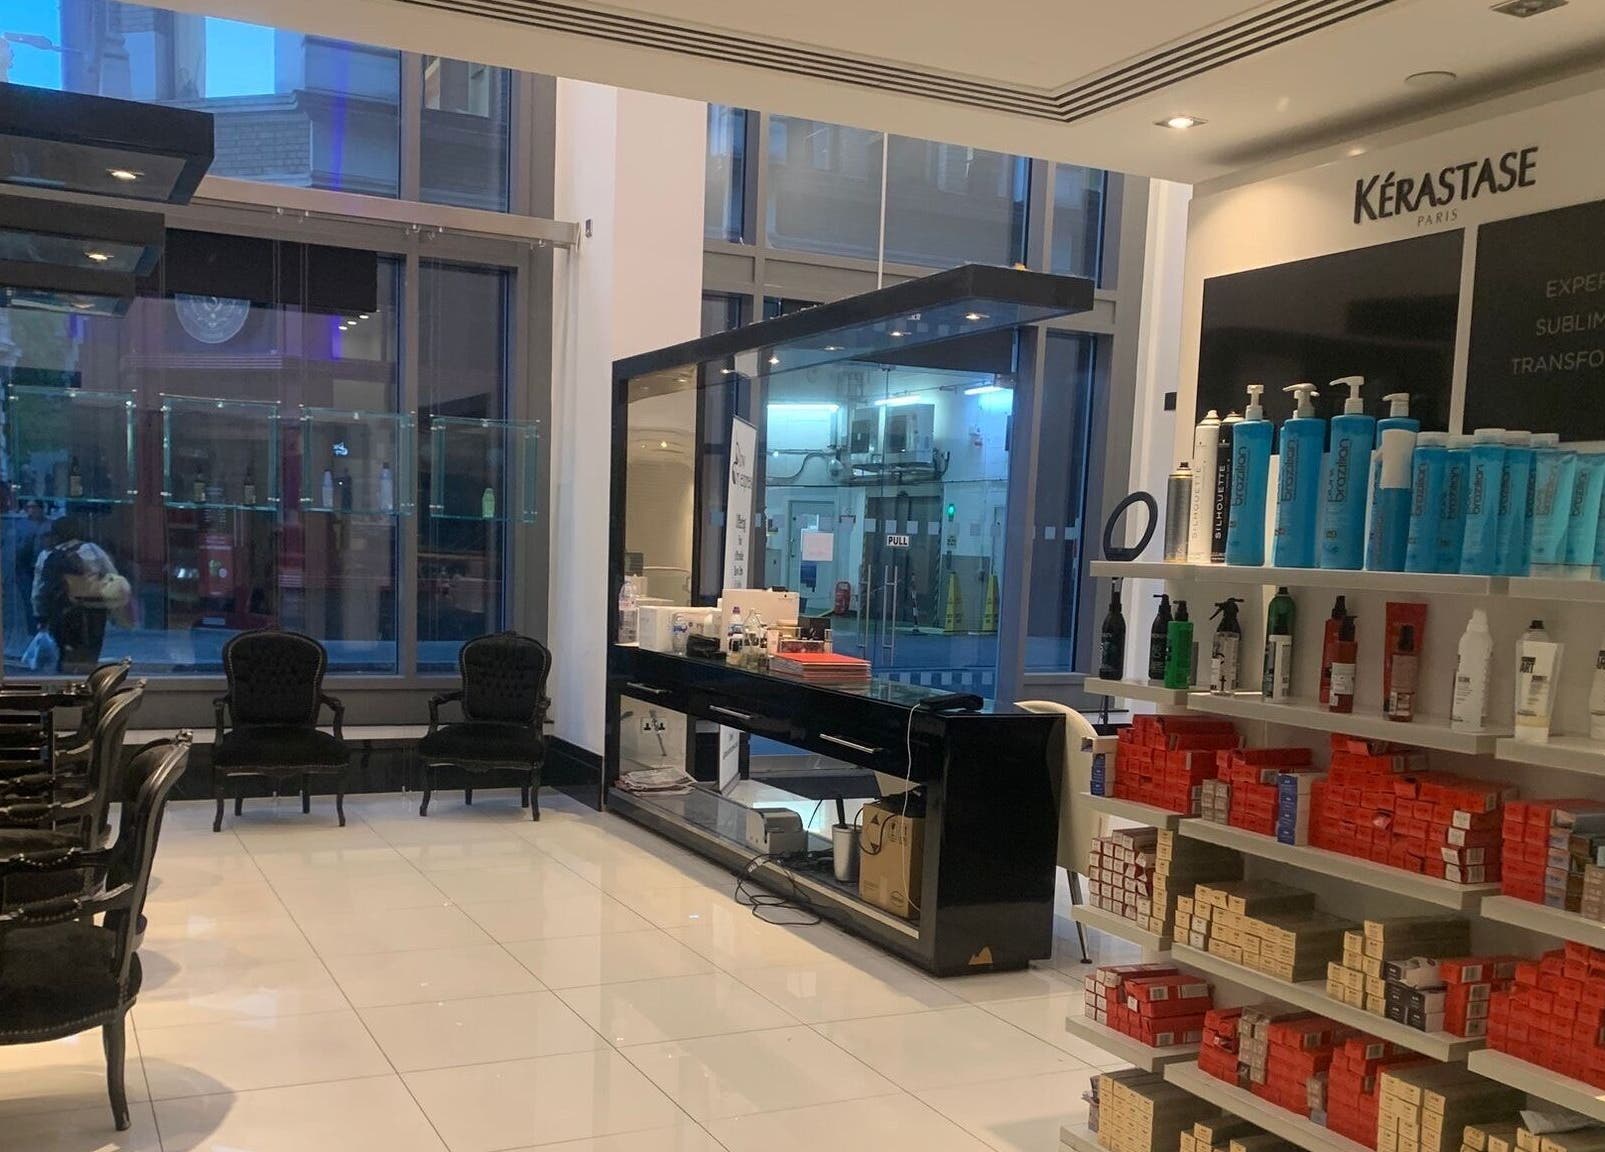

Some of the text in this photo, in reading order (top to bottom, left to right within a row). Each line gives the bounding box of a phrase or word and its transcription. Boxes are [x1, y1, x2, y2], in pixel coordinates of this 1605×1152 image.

[1353, 146, 1539, 224] KÉRASTASE
[1417, 208, 1458, 228] PARIS
[1511, 350, 1605, 375] TRANSFO
[1214, 465, 1226, 540] SILHOUETTE
[888, 536, 908, 546] PULL
